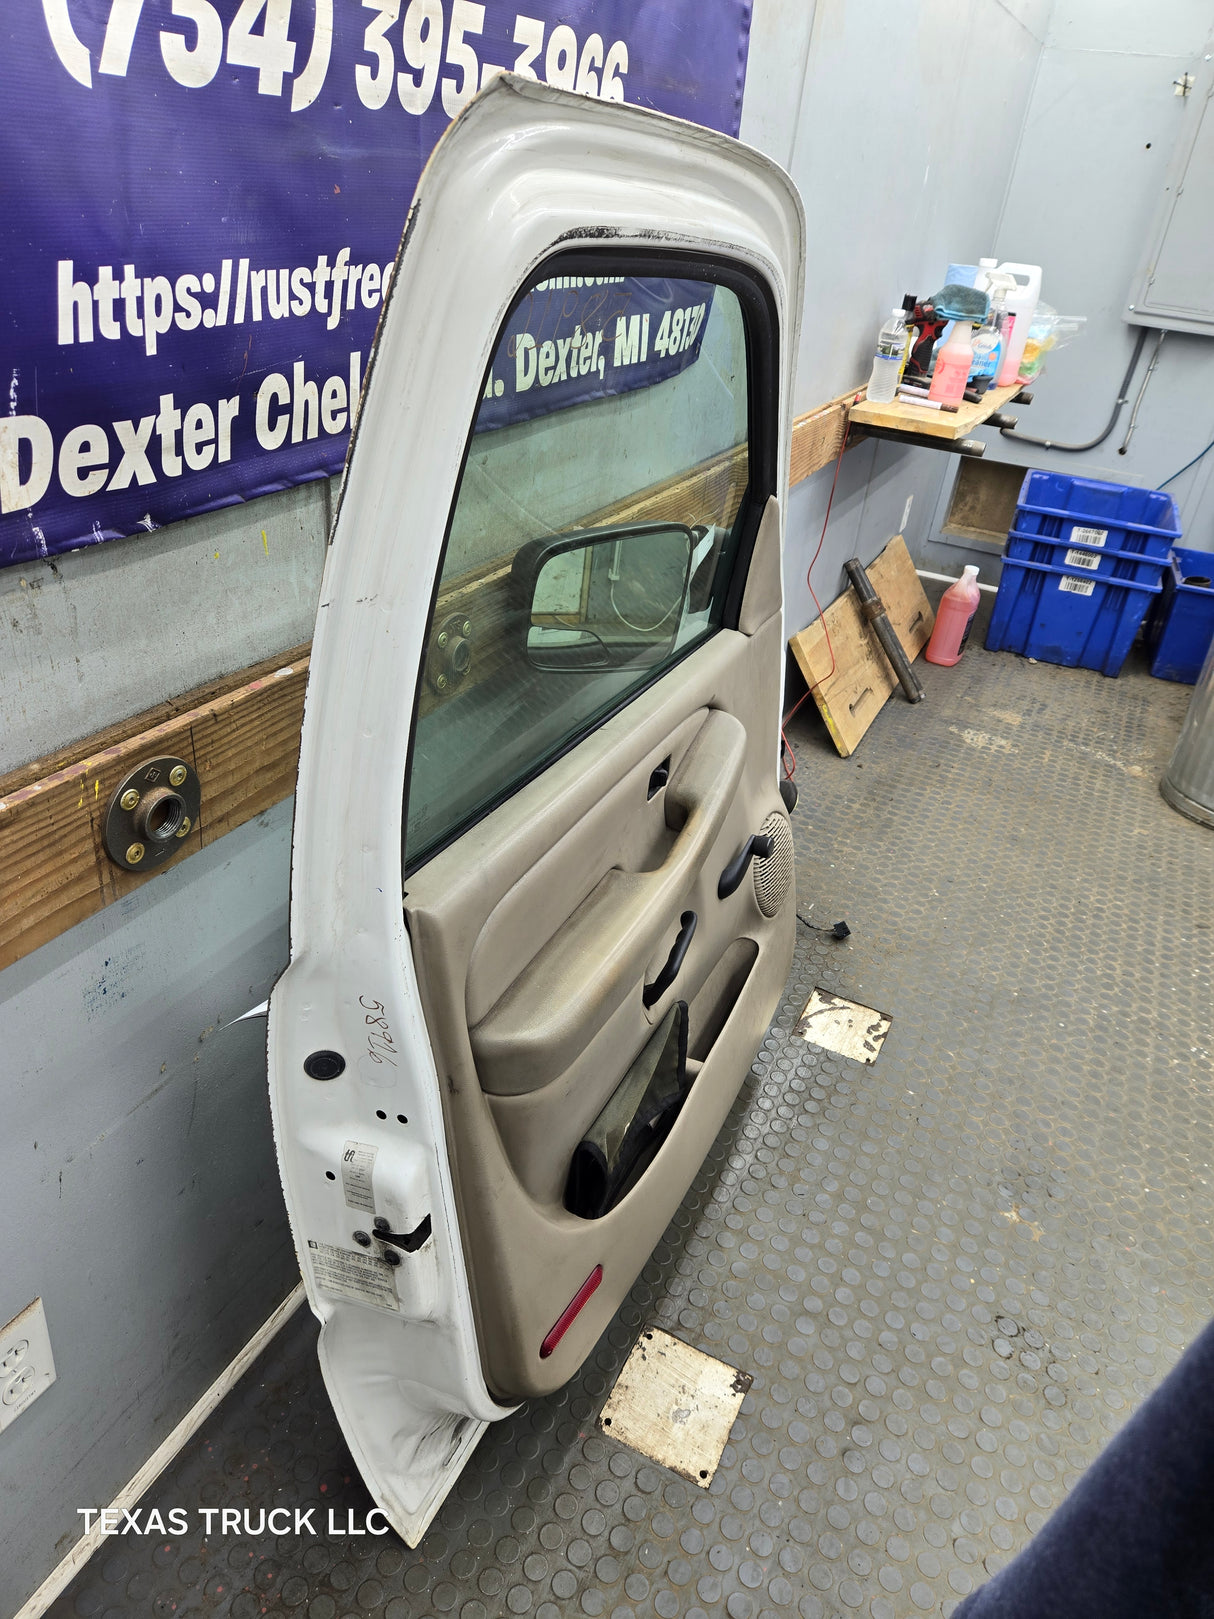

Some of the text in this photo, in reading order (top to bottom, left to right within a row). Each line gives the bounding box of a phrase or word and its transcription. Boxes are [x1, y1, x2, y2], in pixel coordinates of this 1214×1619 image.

[0, 394, 240, 514] Dexter
[515, 325, 606, 393] Dexter,
[613, 313, 650, 367] MI
